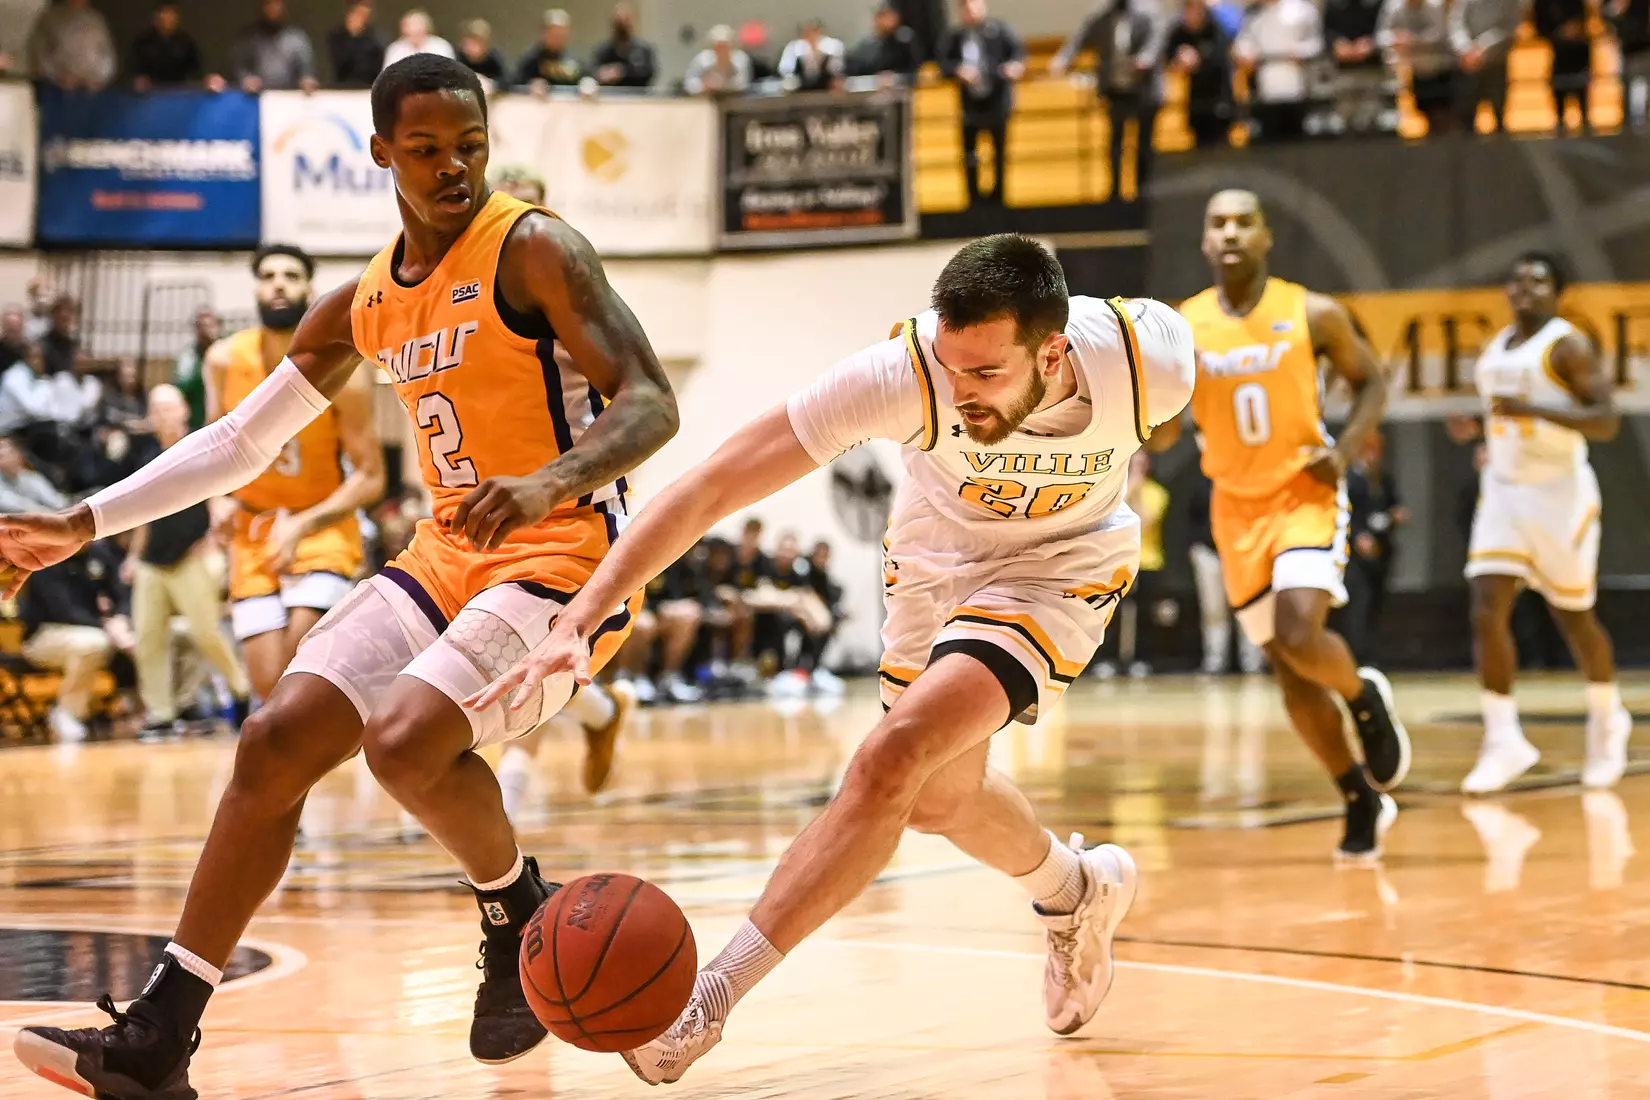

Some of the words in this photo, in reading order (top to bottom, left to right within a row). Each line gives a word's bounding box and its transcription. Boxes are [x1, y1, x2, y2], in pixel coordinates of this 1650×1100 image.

[452, 283, 479, 299] PSAC
[1233, 382, 1271, 447] 0
[415, 390, 479, 488] 2
[960, 448, 1114, 476] VILLE
[957, 475, 1095, 519] 20
